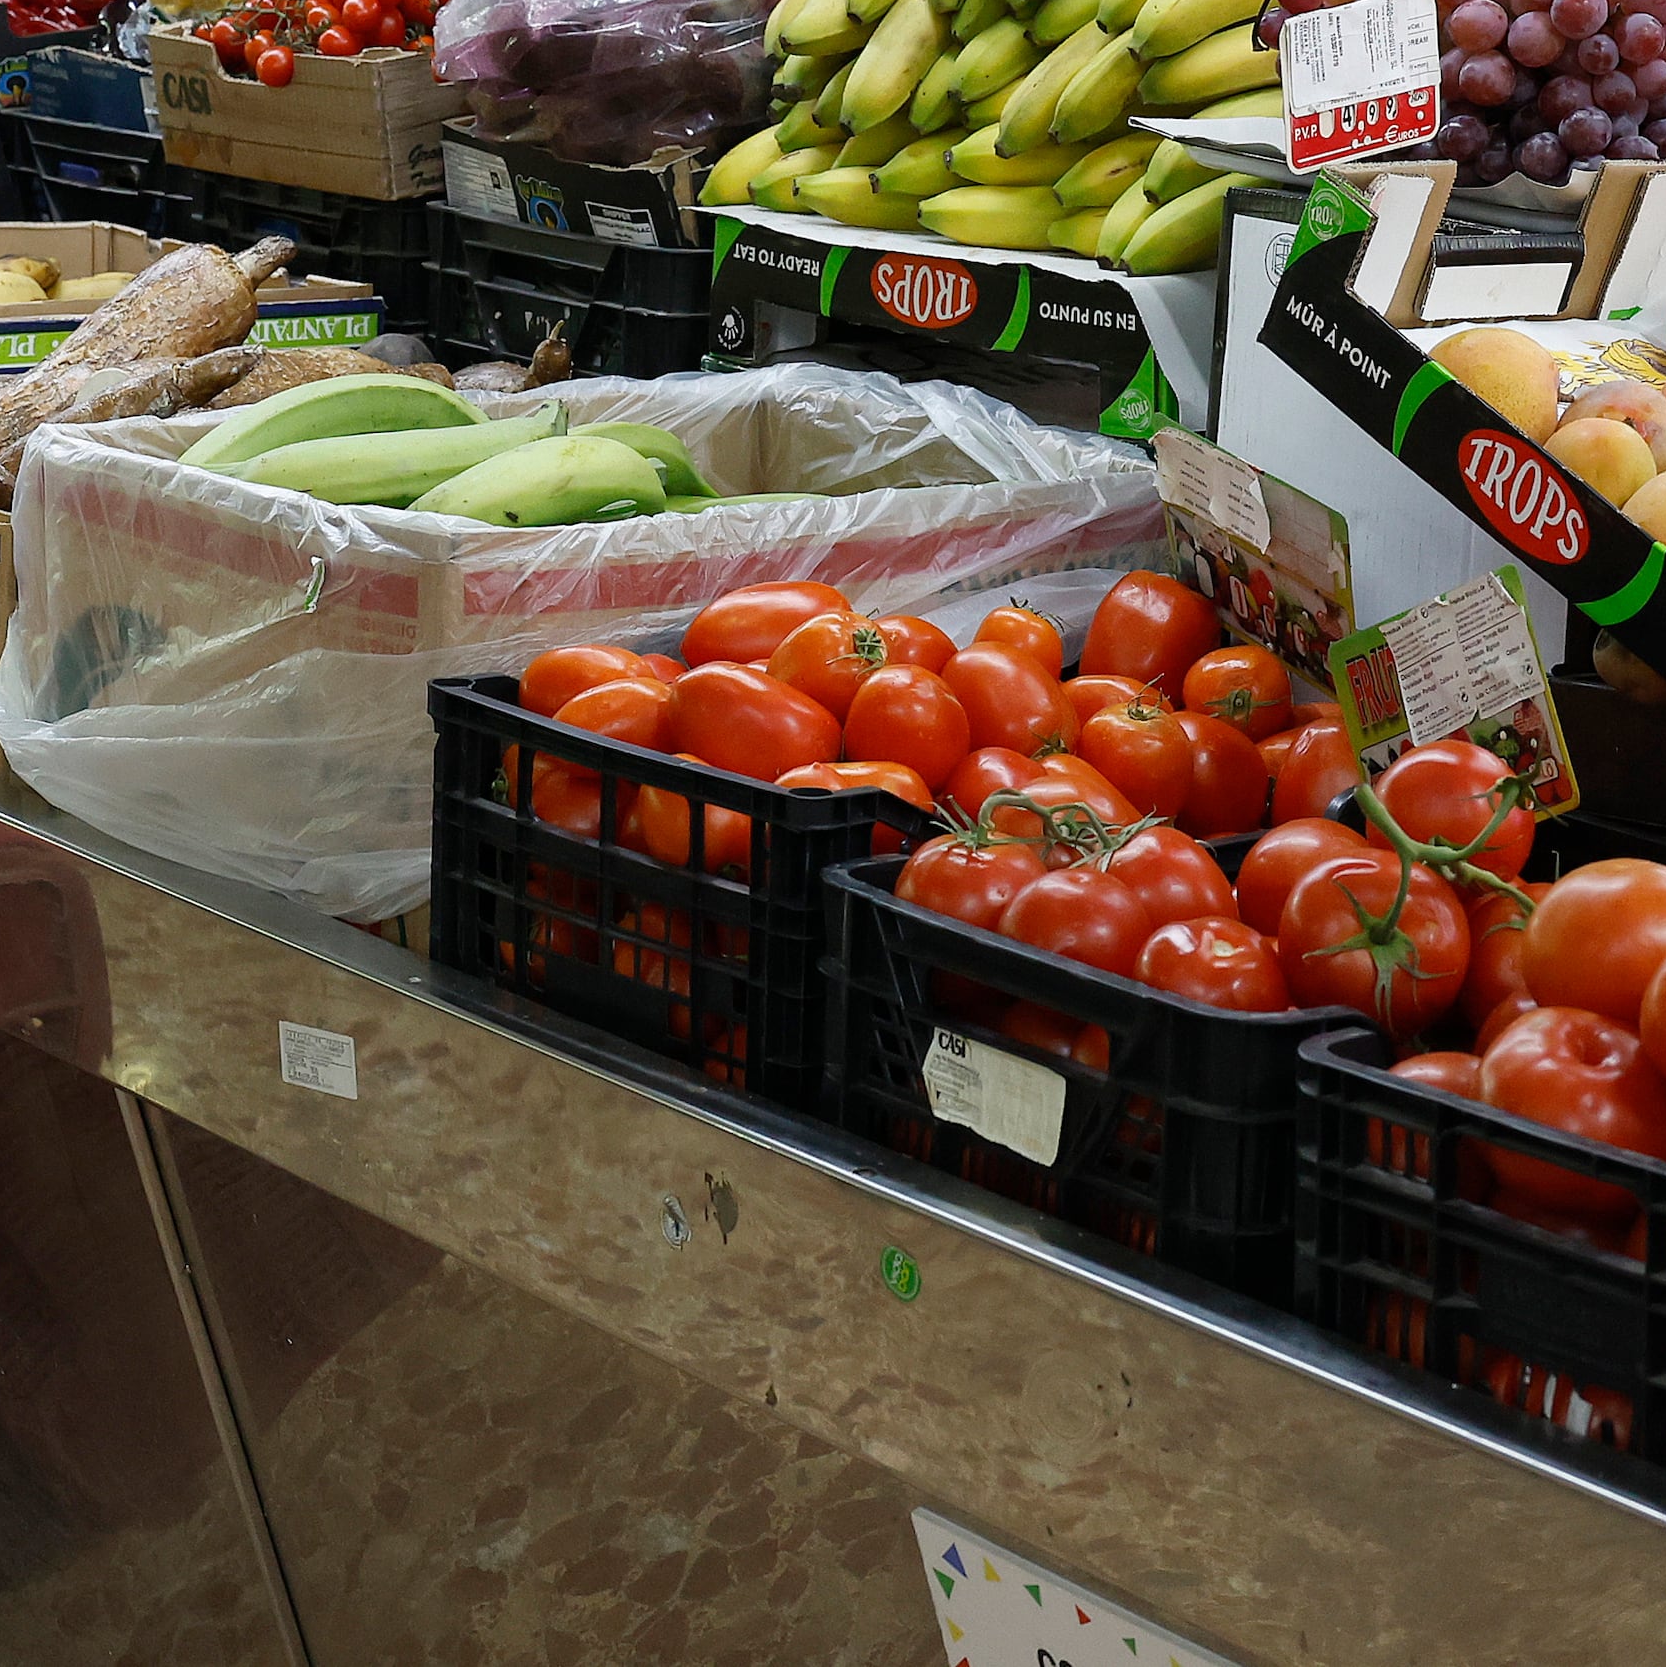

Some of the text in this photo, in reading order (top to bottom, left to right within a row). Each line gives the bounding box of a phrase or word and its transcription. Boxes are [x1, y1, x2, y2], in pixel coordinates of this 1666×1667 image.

[161, 72, 212, 116] CASI
[733, 242, 1136, 332] READY TO EAT TROPS EN SU PUNTO
[1285, 293, 1392, 391] MÛR À POINT
[1120, 401, 1150, 422] TROPS
[1463, 436, 1585, 561] TROPS
[937, 1032, 966, 1059] CASI
